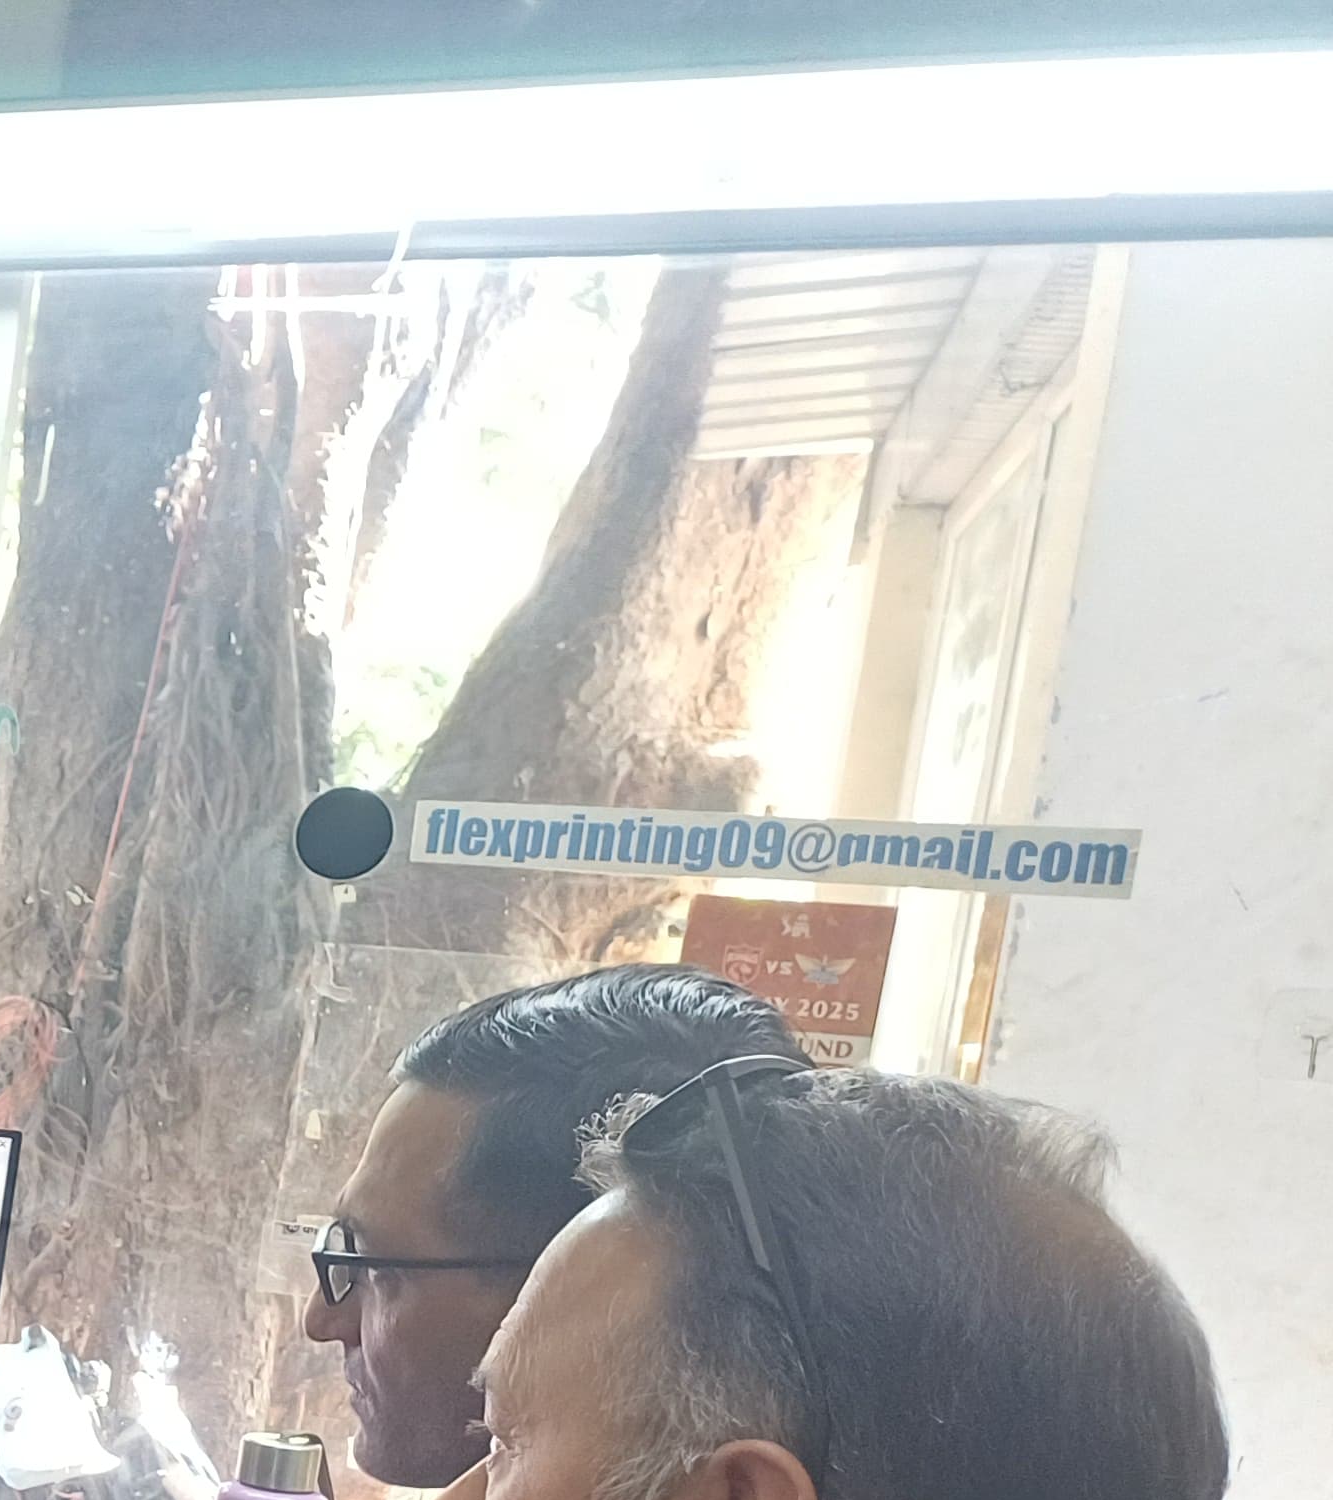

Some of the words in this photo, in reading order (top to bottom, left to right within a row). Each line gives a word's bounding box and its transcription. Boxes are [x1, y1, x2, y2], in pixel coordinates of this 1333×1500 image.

[425, 808, 1129, 885] flexprinting09@gmail.com
[796, 998, 861, 1022] 2025
[800, 1037, 854, 1059] UND
